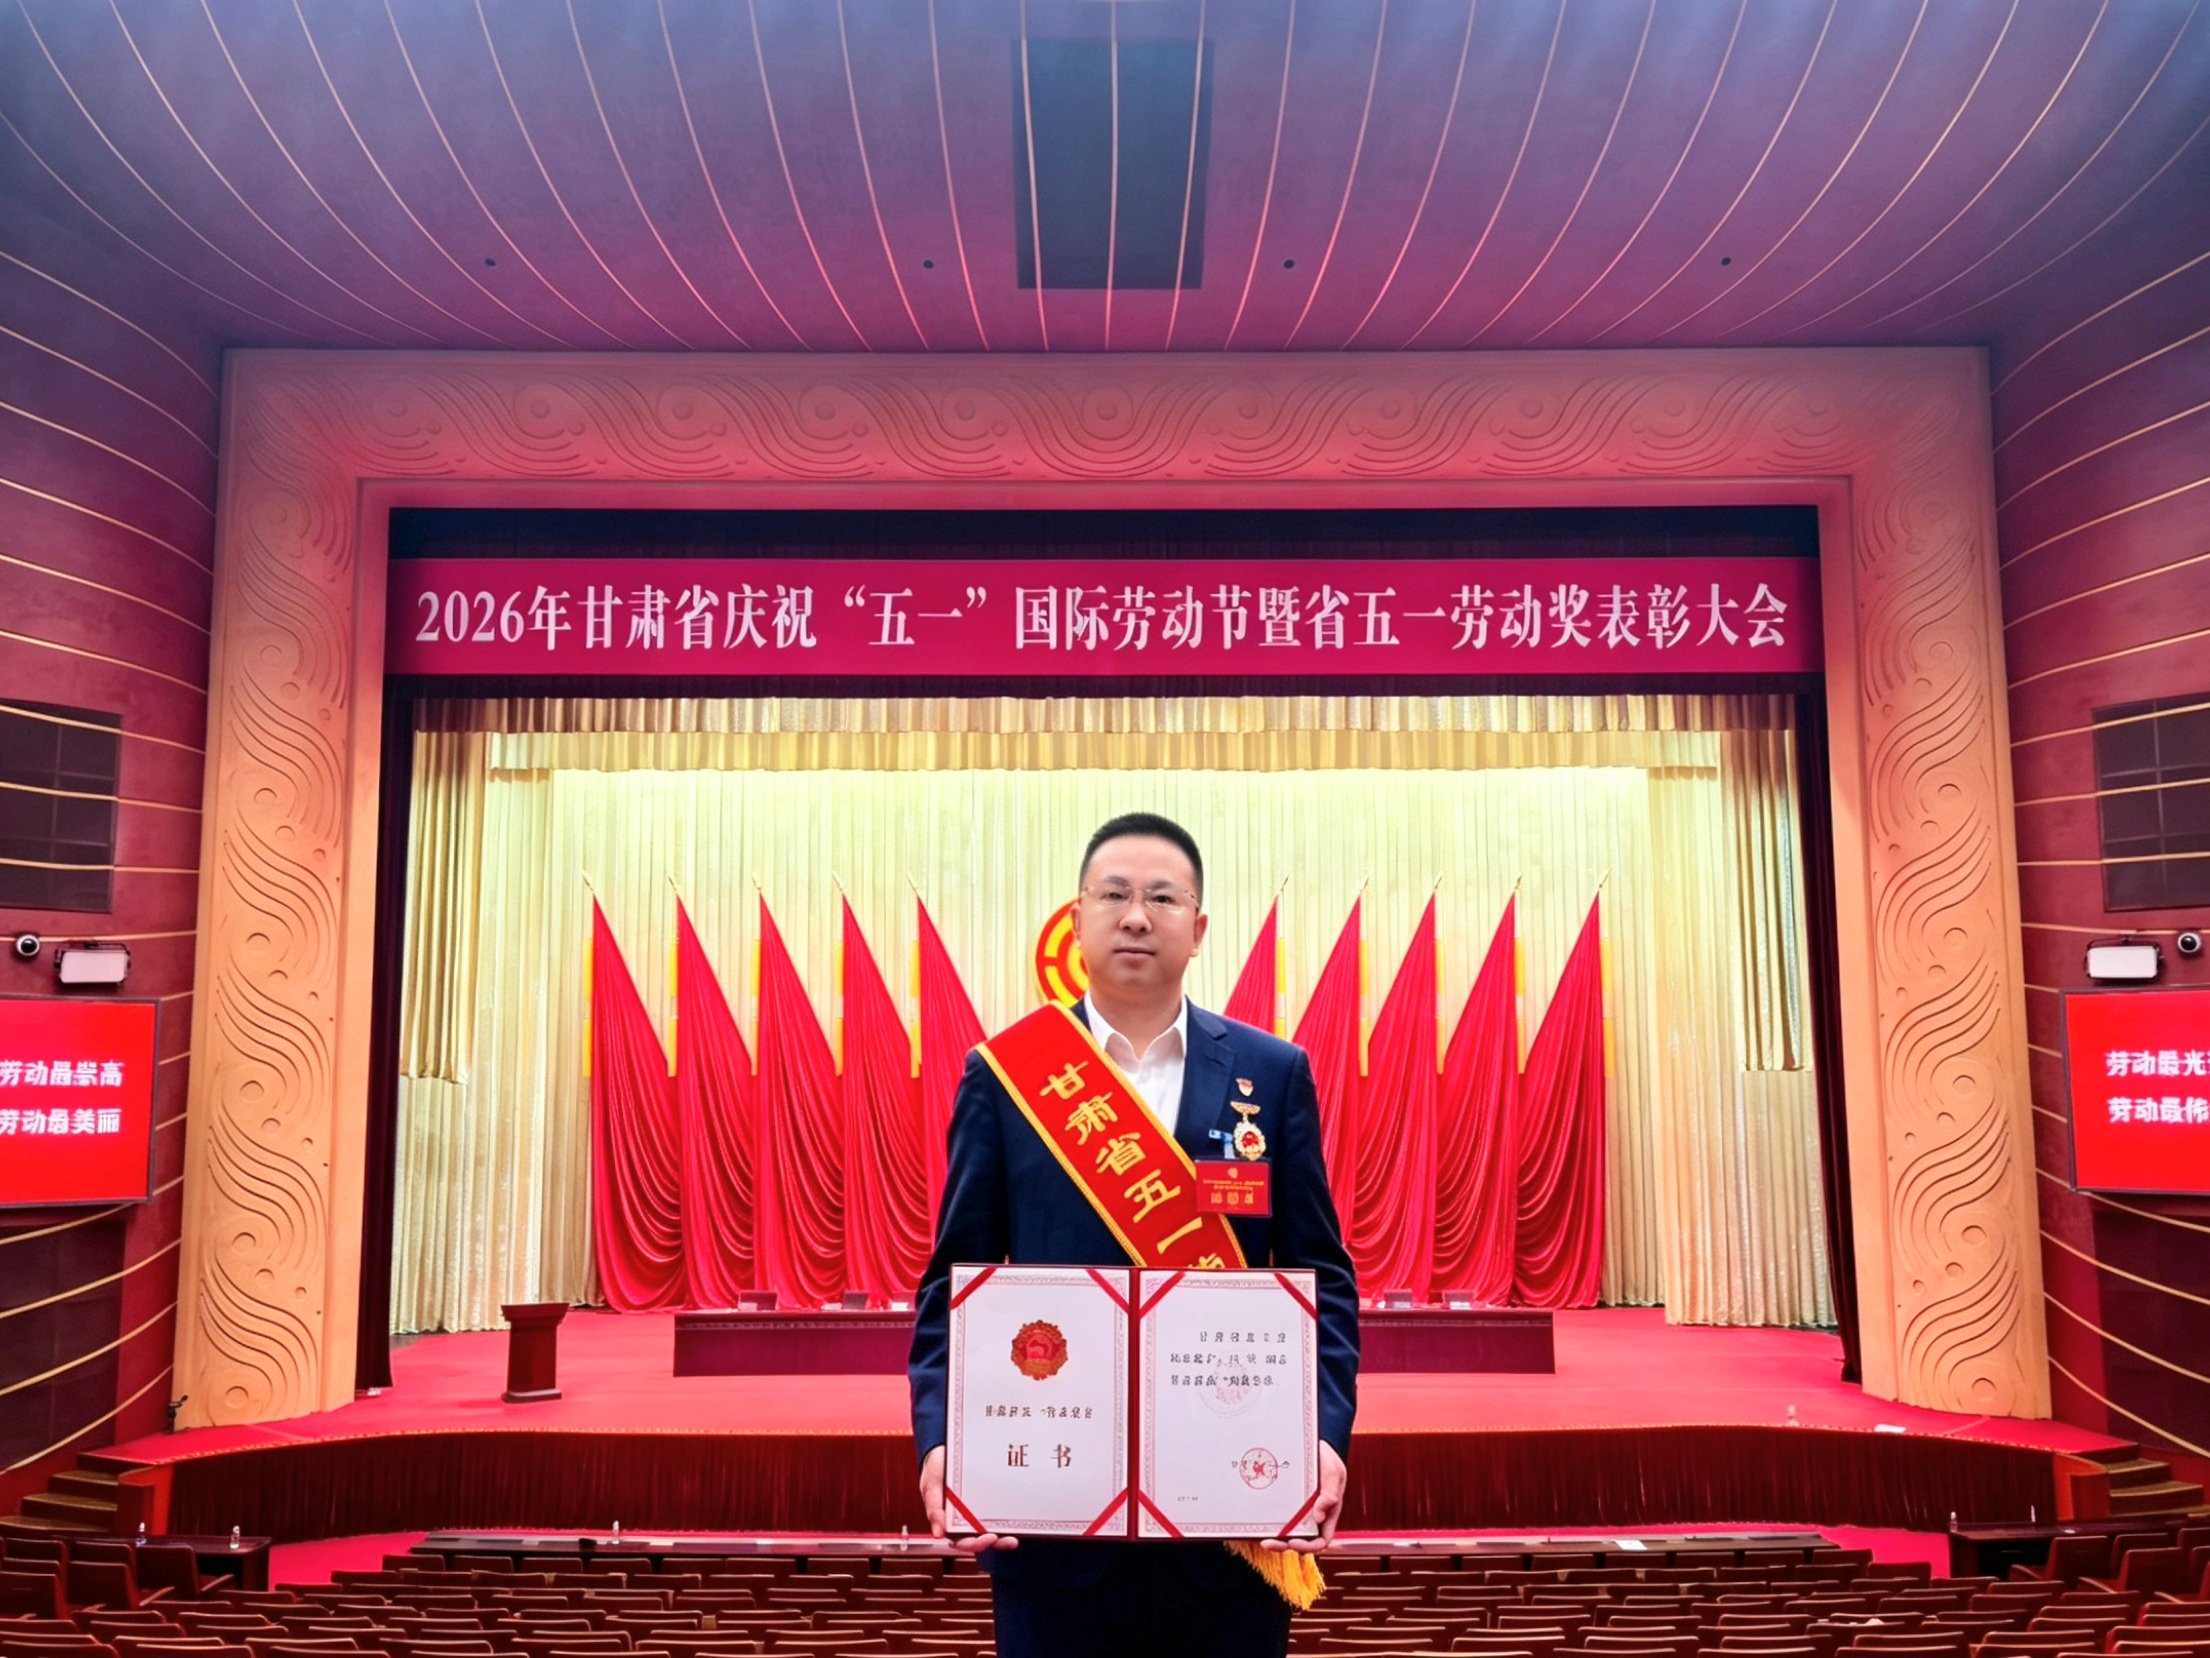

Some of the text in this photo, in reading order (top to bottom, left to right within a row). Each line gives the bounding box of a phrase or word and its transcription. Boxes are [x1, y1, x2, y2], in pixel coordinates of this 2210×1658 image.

[416, 583, 1787, 651] 2026年甘肃省庆祝“五一”国际劳动节暨省五一劳动奖表彰大会
[2106, 1049, 2210, 1077] 劳动最光
[1007, 1443, 1072, 1469] 证书
